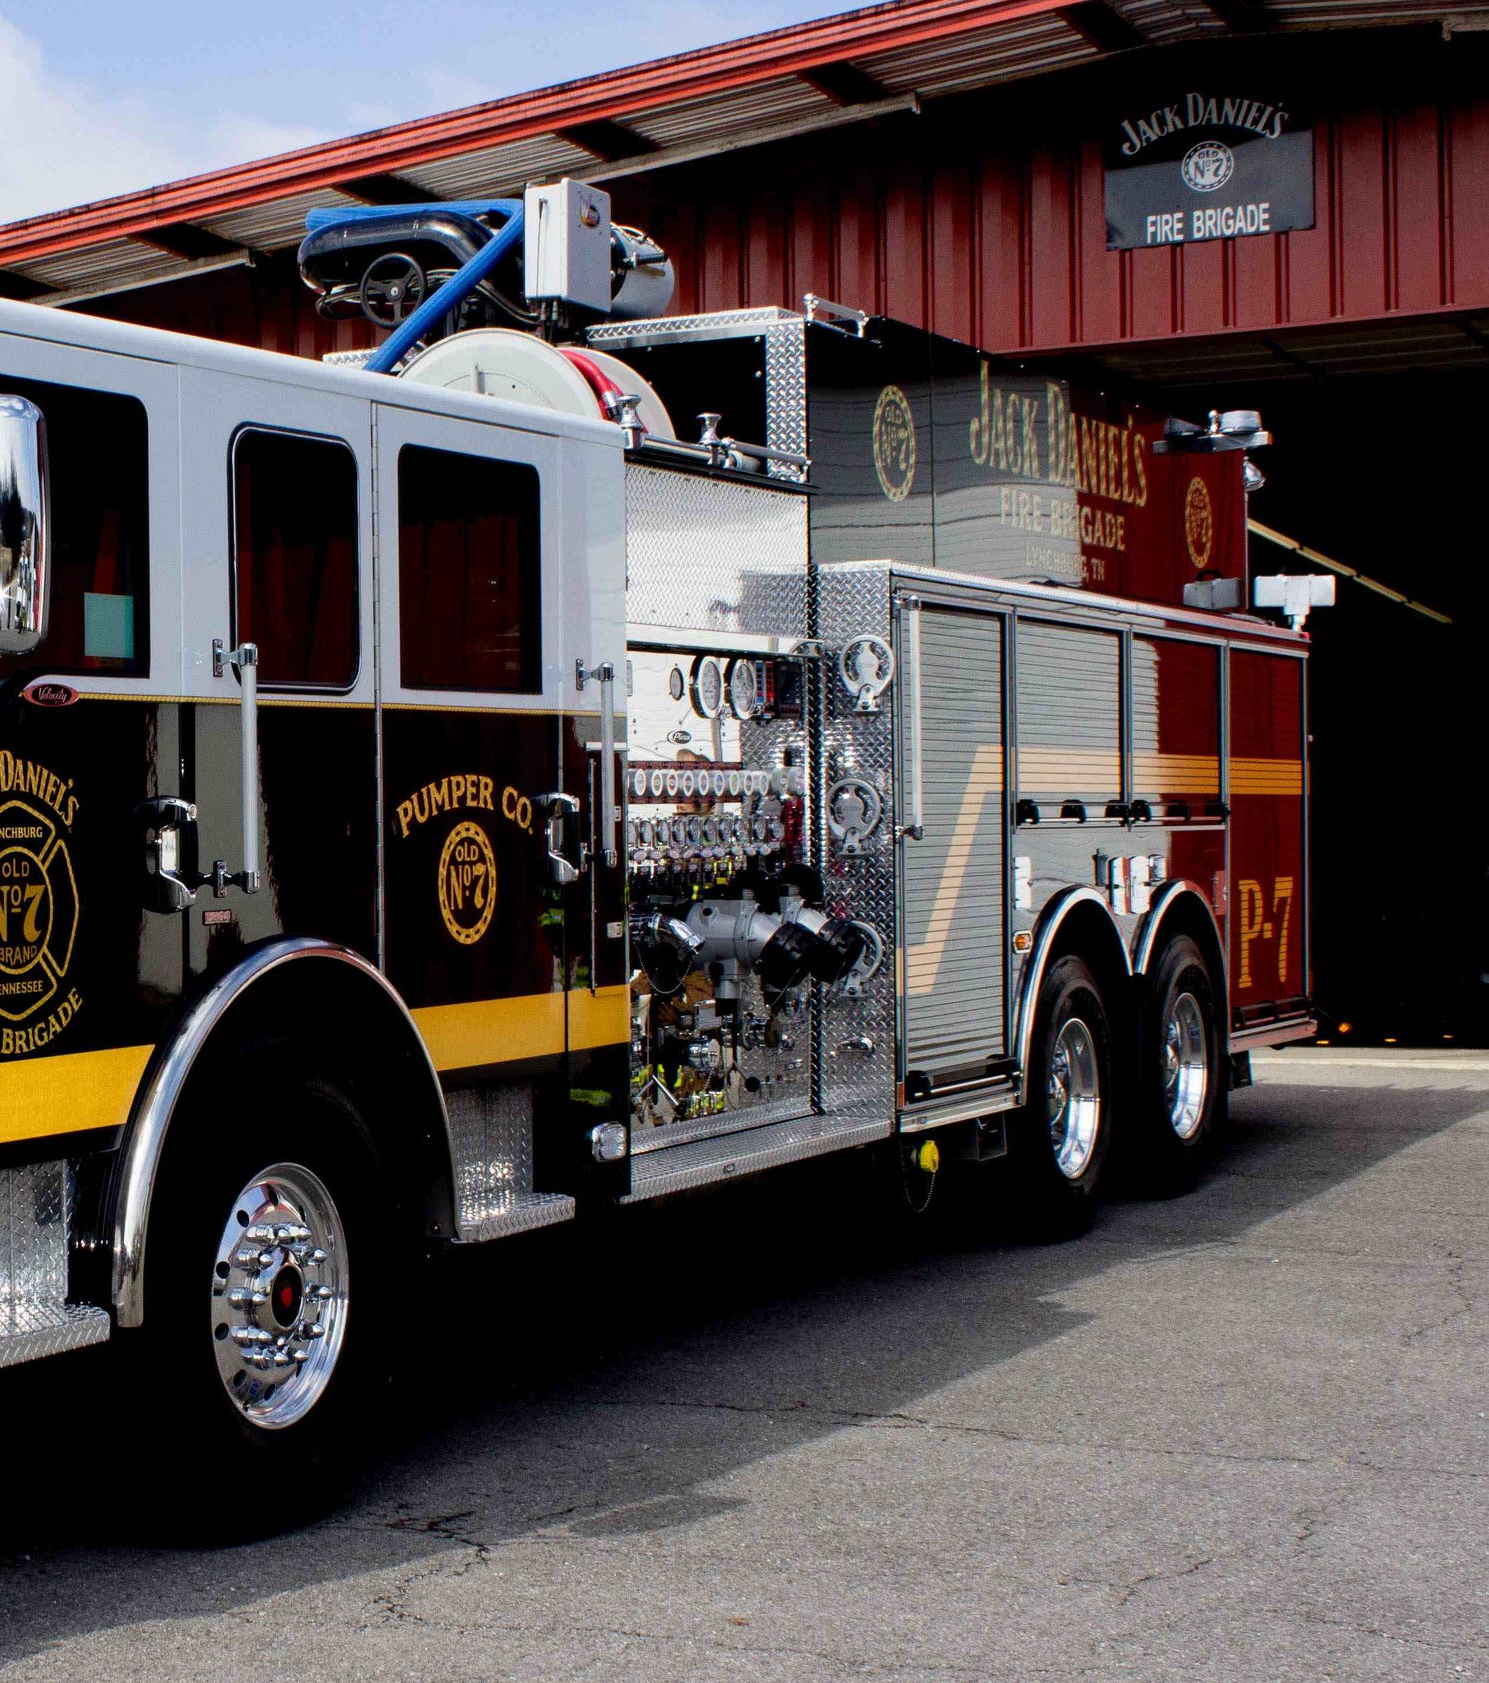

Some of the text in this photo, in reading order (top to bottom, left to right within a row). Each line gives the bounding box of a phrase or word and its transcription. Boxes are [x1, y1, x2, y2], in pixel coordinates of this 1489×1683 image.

[1120, 92, 1290, 156] JACK DANIEL'S
[1198, 150, 1219, 160] OLD
[1146, 203, 1270, 244] FIRE BRIGADE
[970, 360, 1147, 508] JACK DANIEL'S
[999, 487, 1126, 551] FIRE BRIGADE
[1091, 558, 1106, 581] TN
[396, 774, 534, 839] PUMPER CO.
[1, 858, 31, 878] OLD
[455, 842, 479, 862] OLD
[1238, 875, 1294, 989] P-7
[0, 987, 84, 1055] BRIGADE
